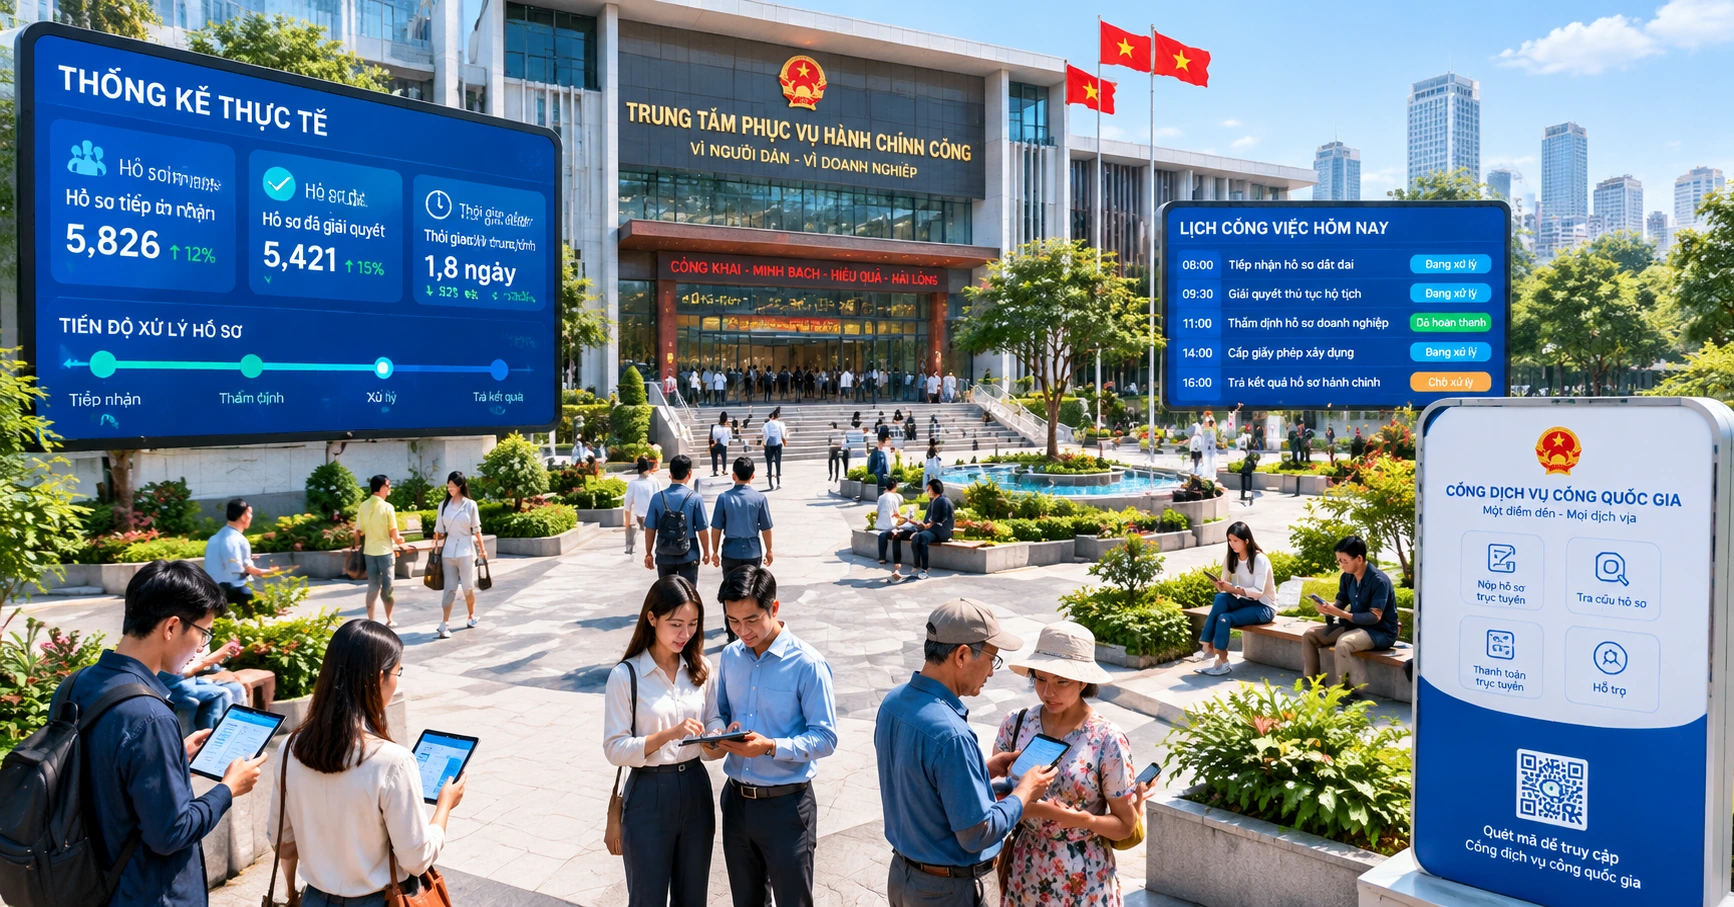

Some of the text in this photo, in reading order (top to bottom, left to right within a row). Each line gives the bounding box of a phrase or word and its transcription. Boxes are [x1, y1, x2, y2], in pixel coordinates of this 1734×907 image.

[218, 94, 291, 131] THỰC
[626, 102, 692, 129] TRUNG
[741, 116, 791, 143] PHỤC
[796, 123, 819, 147] VỤ
[824, 123, 871, 150] HÀNH
[690, 141, 705, 156] VÌ
[803, 152, 817, 168] VÌ
[821, 156, 868, 173] DOANH
[1180, 221, 1217, 238] LỊCH
[1356, 221, 1389, 235] NAY
[66, 223, 160, 259] 5,826
[185, 246, 217, 264] 12%
[263, 240, 336, 272] 5,421
[357, 260, 385, 276] 15%
[425, 254, 459, 282] 1,8
[711, 262, 741, 275] KHAI
[788, 267, 820, 280] BACH
[1182, 260, 1214, 270] 08:00
[1182, 289, 1214, 299] 09:30
[1182, 318, 1212, 328] 11:00
[1317, 317, 1350, 328] doanh
[220, 324, 243, 339] SƠ
[1182, 347, 1213, 358] 14:00
[1182, 377, 1212, 388] 16:00
[1490, 486, 1525, 502] DỊCH
[1528, 488, 1549, 503] VỤ
[1652, 493, 1682, 507] GIA
[1566, 509, 1588, 522] Mọi
[1577, 592, 1593, 603] Tra
[1473, 665, 1502, 677] Thanh
[1560, 842, 1589, 860] truy
[1620, 874, 1641, 889] gia
